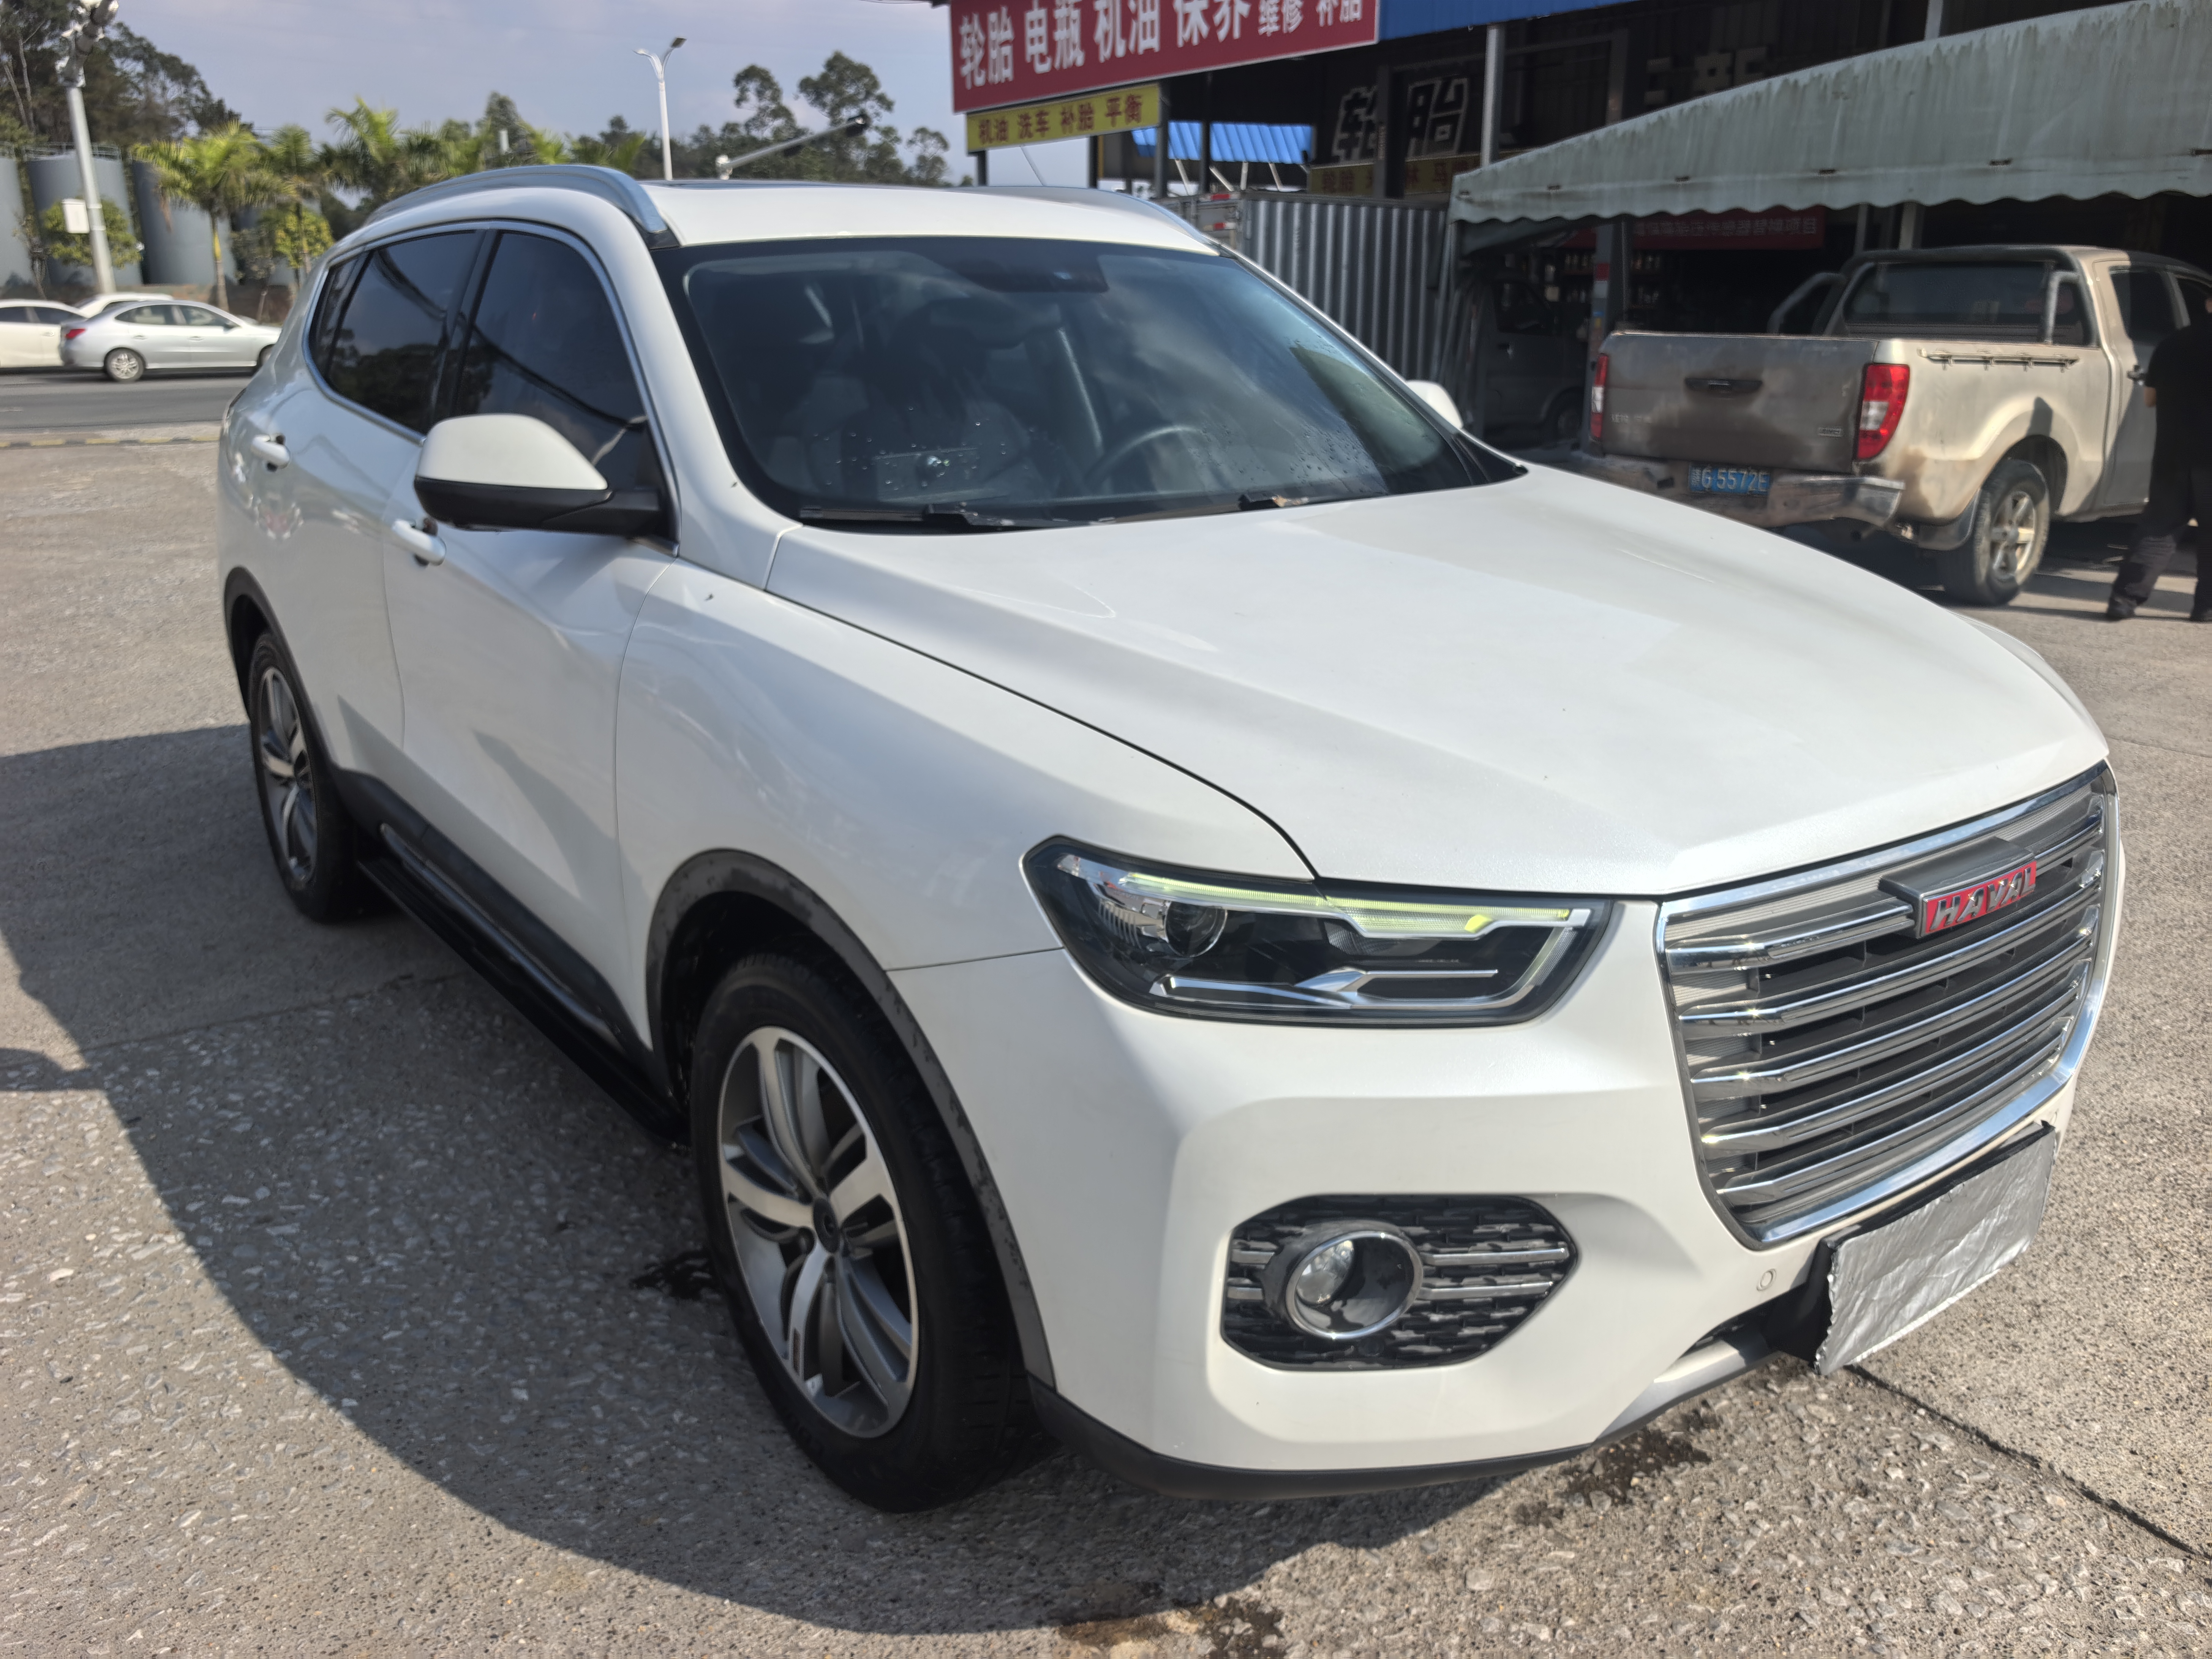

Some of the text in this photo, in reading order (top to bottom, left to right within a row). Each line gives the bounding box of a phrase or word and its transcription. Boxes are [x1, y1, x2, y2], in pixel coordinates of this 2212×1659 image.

[959, 5, 1015, 90] 轮胎
[1024, 0, 1085, 74] 电瓶
[1093, 0, 1160, 63] 机油
[1929, 866, 2035, 931] HAVAL
